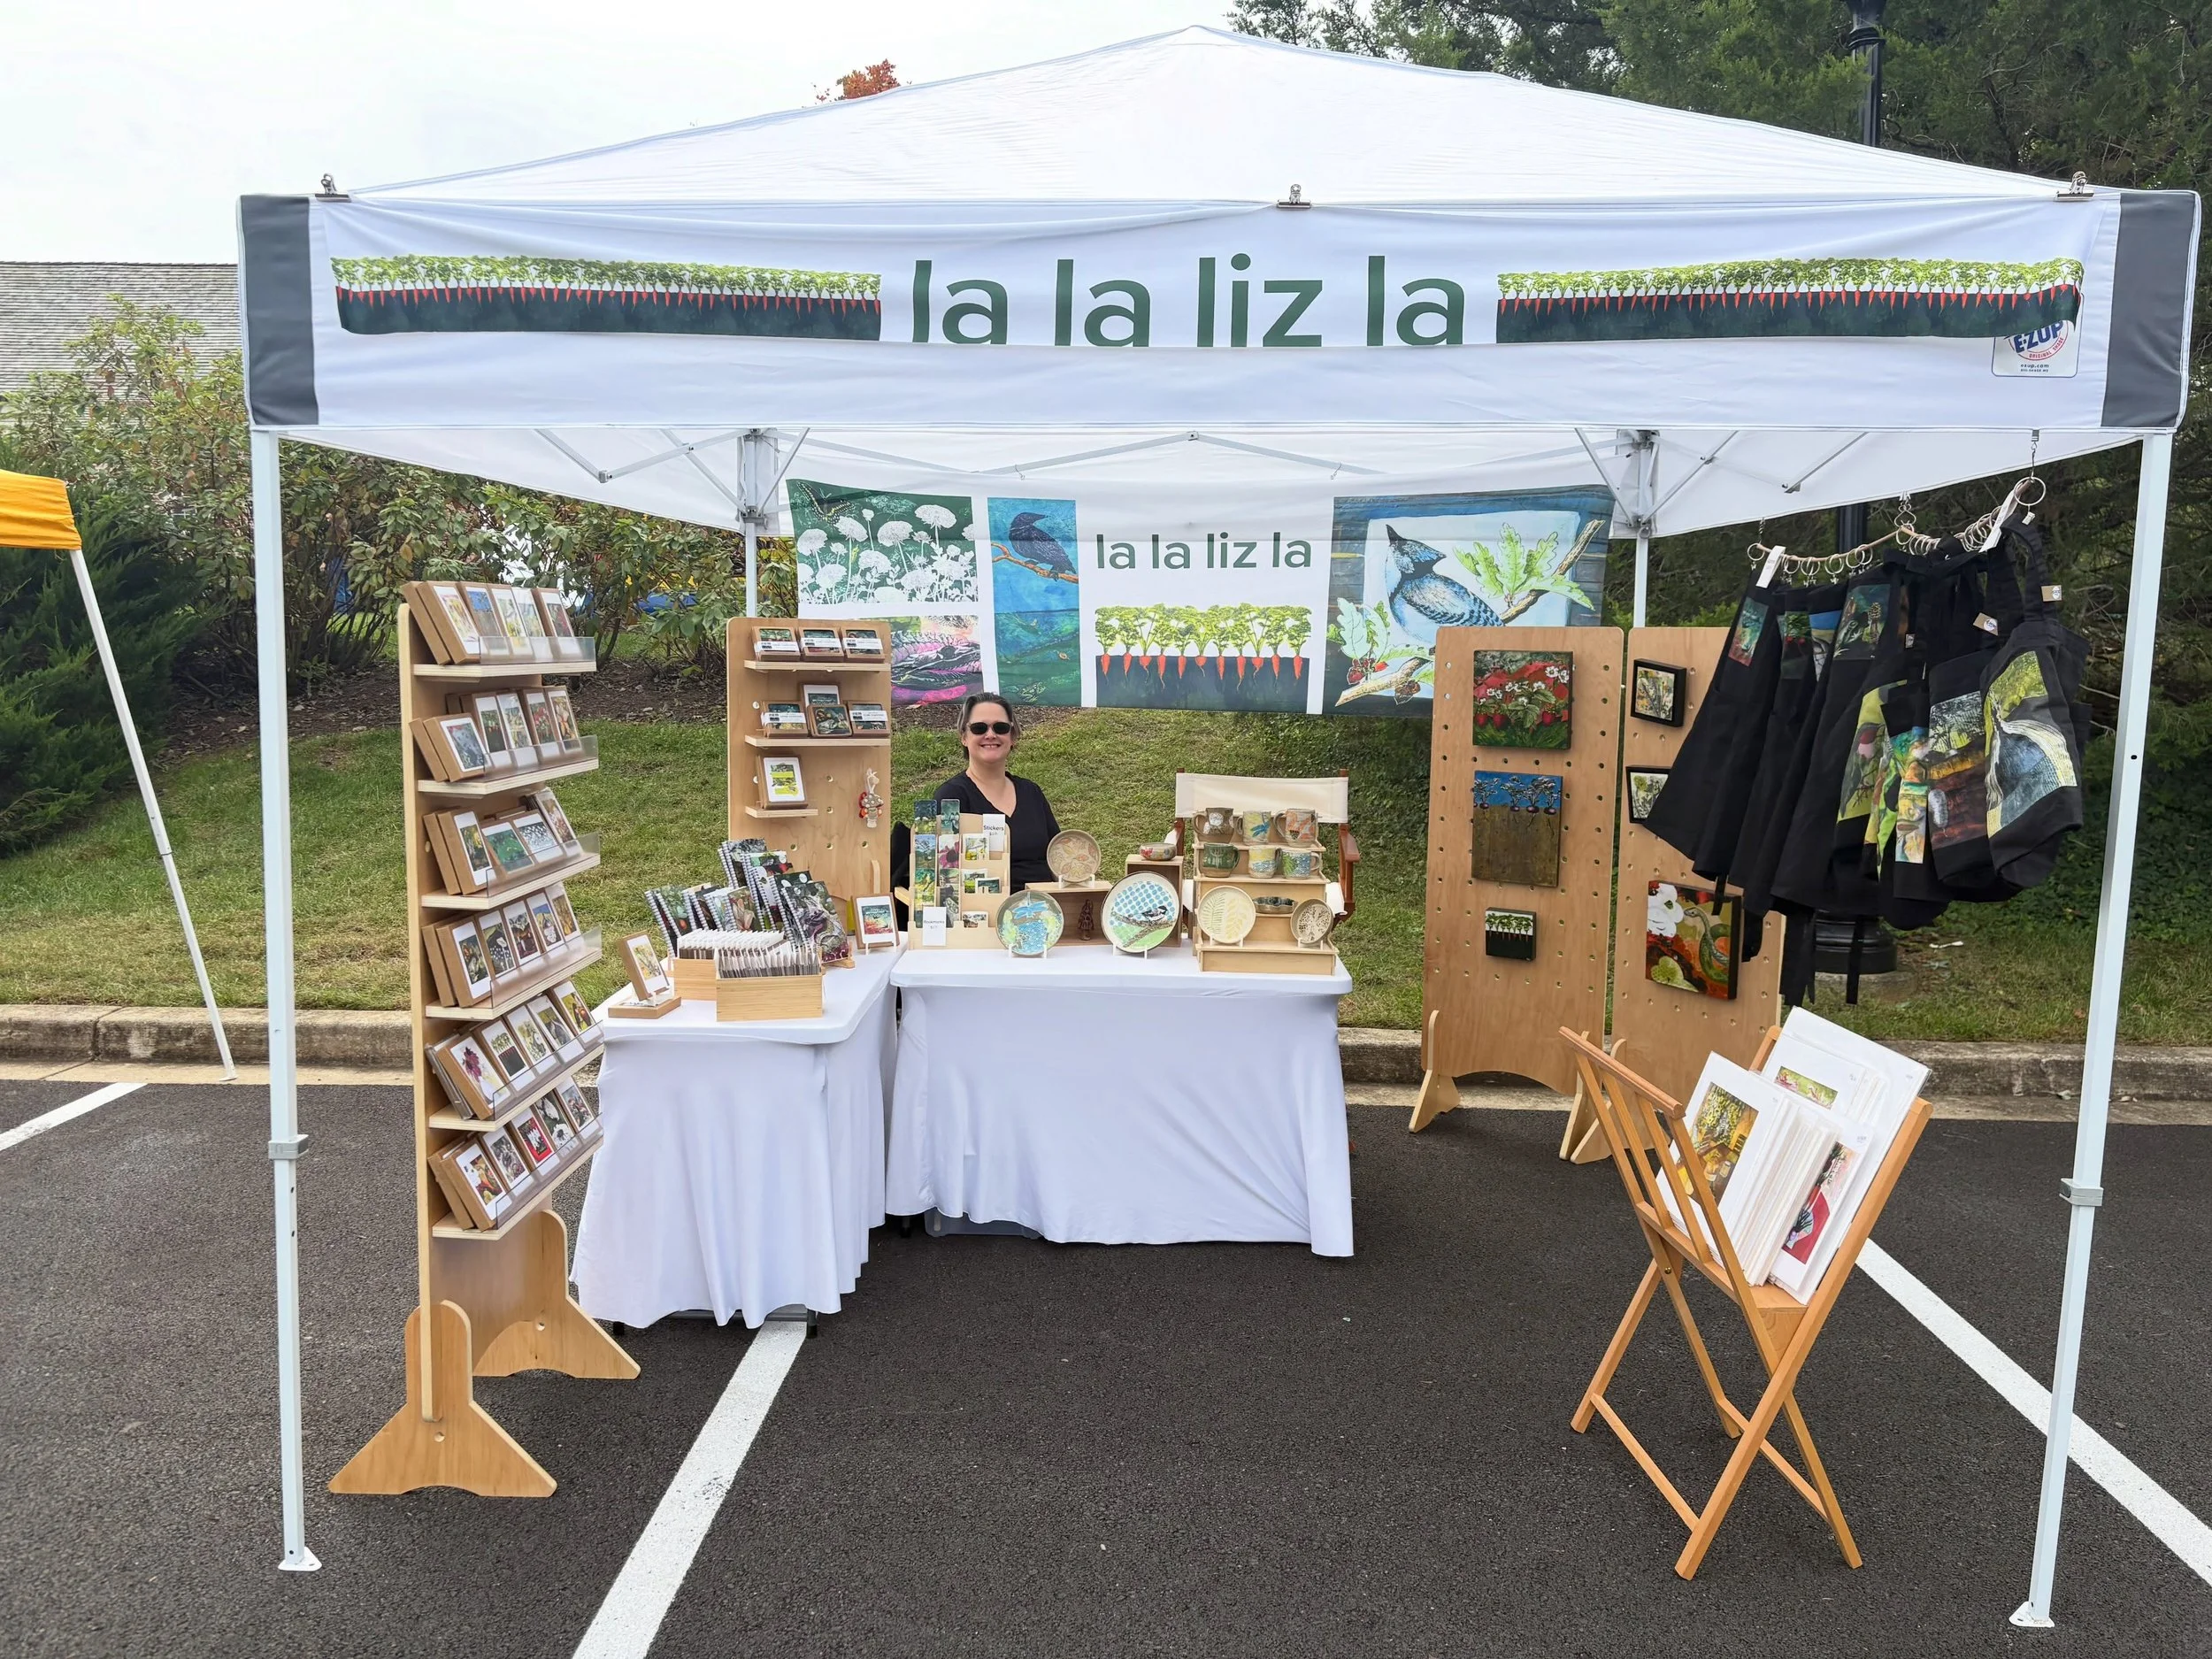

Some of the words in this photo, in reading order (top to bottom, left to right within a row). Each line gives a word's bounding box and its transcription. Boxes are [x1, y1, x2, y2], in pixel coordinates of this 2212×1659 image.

[912, 260, 1008, 345] la
[1055, 259, 1150, 347] la
[1197, 253, 1323, 347] liz
[1366, 255, 1464, 347] la
[1096, 534, 1136, 569] la
[1151, 534, 1191, 569] la
[1207, 532, 1257, 569] liz
[1272, 532, 1312, 568] la
